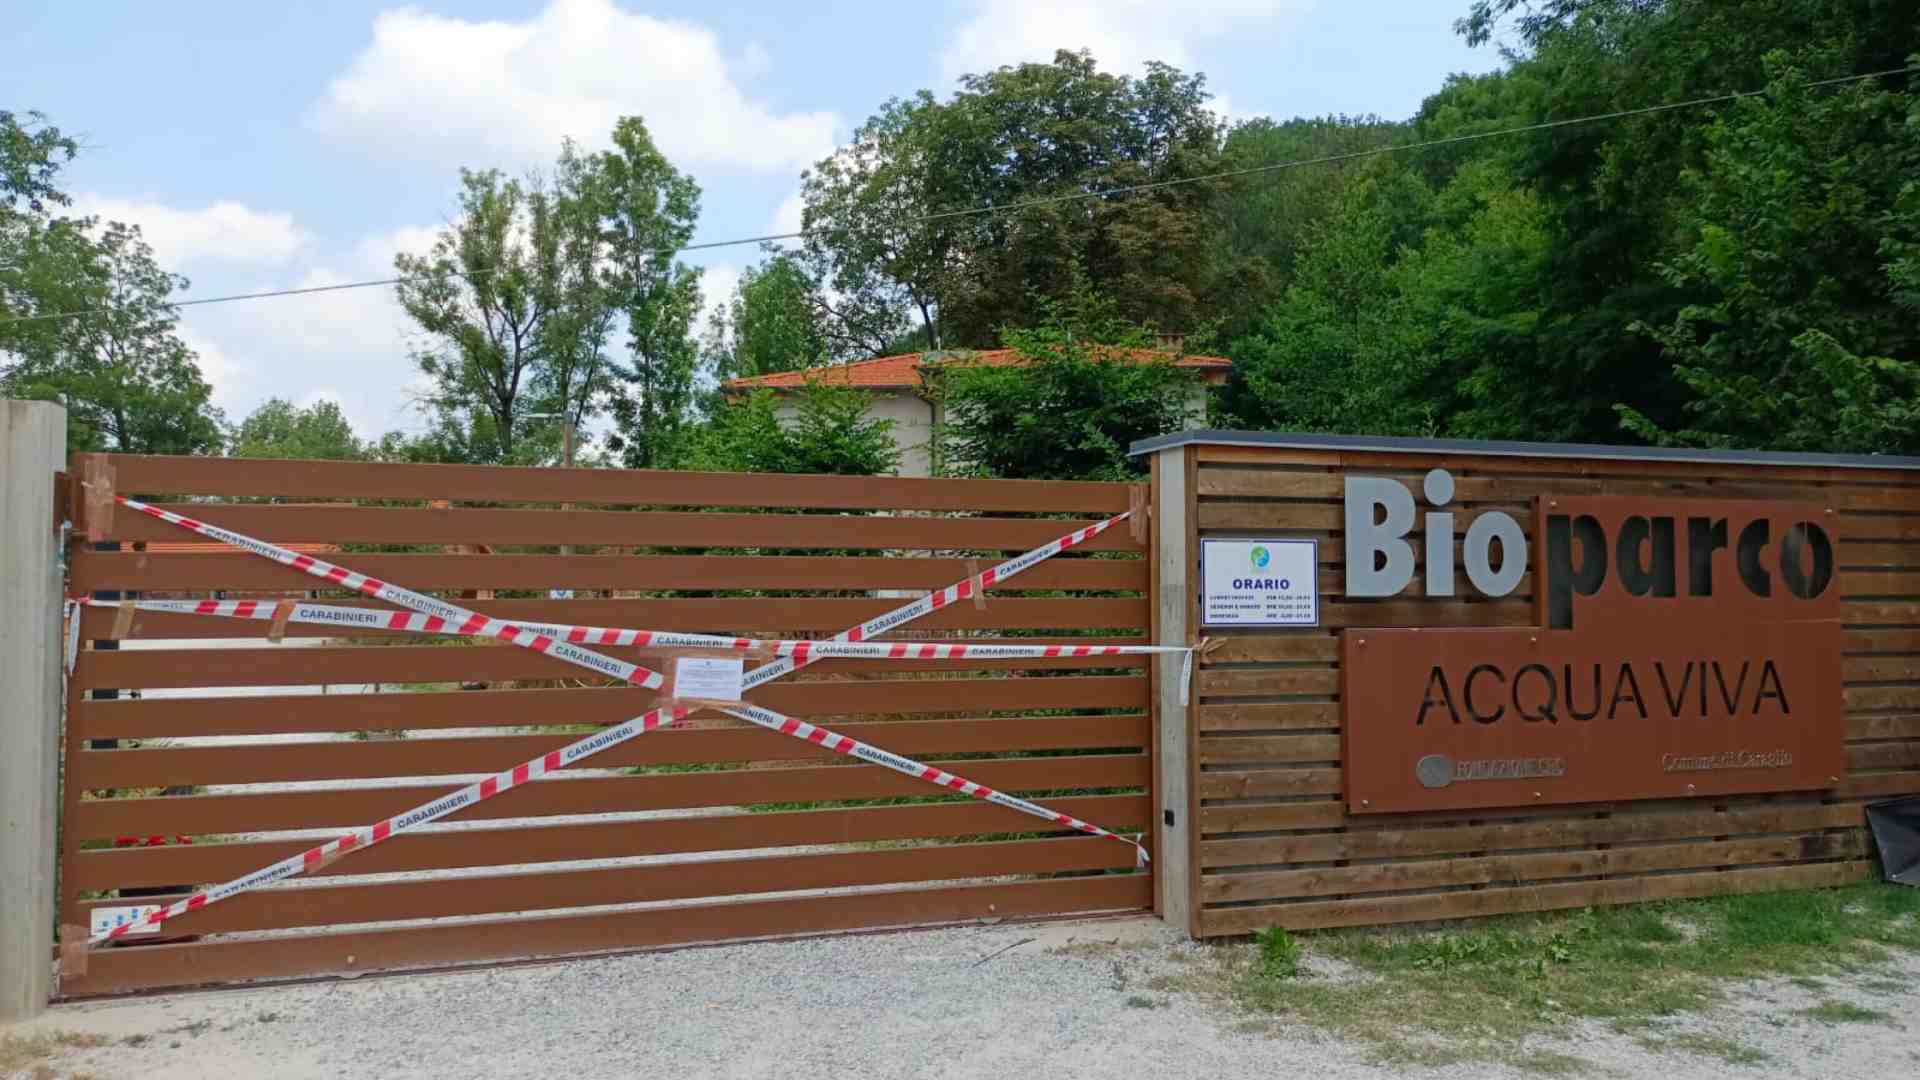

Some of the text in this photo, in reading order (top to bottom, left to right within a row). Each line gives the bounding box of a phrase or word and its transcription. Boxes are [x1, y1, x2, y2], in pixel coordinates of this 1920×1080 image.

[205, 527, 282, 560] CARABINIERI
[1345, 468, 1833, 630] Bioparco
[999, 545, 1054, 576] CARABINIERI
[1232, 578, 1291, 590] ORARIO
[300, 608, 378, 625] CARABINIERI
[385, 588, 458, 620] CARABINIERI
[866, 602, 925, 634] CARABINIERI
[656, 635, 724, 648] CARABINIERI
[815, 645, 881, 657] CARABINIERI
[971, 646, 1036, 657] CARABINIERI
[554, 644, 623, 674] CARABINIERI
[741, 662, 785, 688] ABINIERI
[1416, 659, 1790, 726] ACQUAVIVA
[566, 725, 634, 760] CARABINIERI
[856, 746, 917, 773] CARABINIERI
[397, 793, 469, 829] CARABINIERI
[214, 863, 292, 897] CARABINIERI
